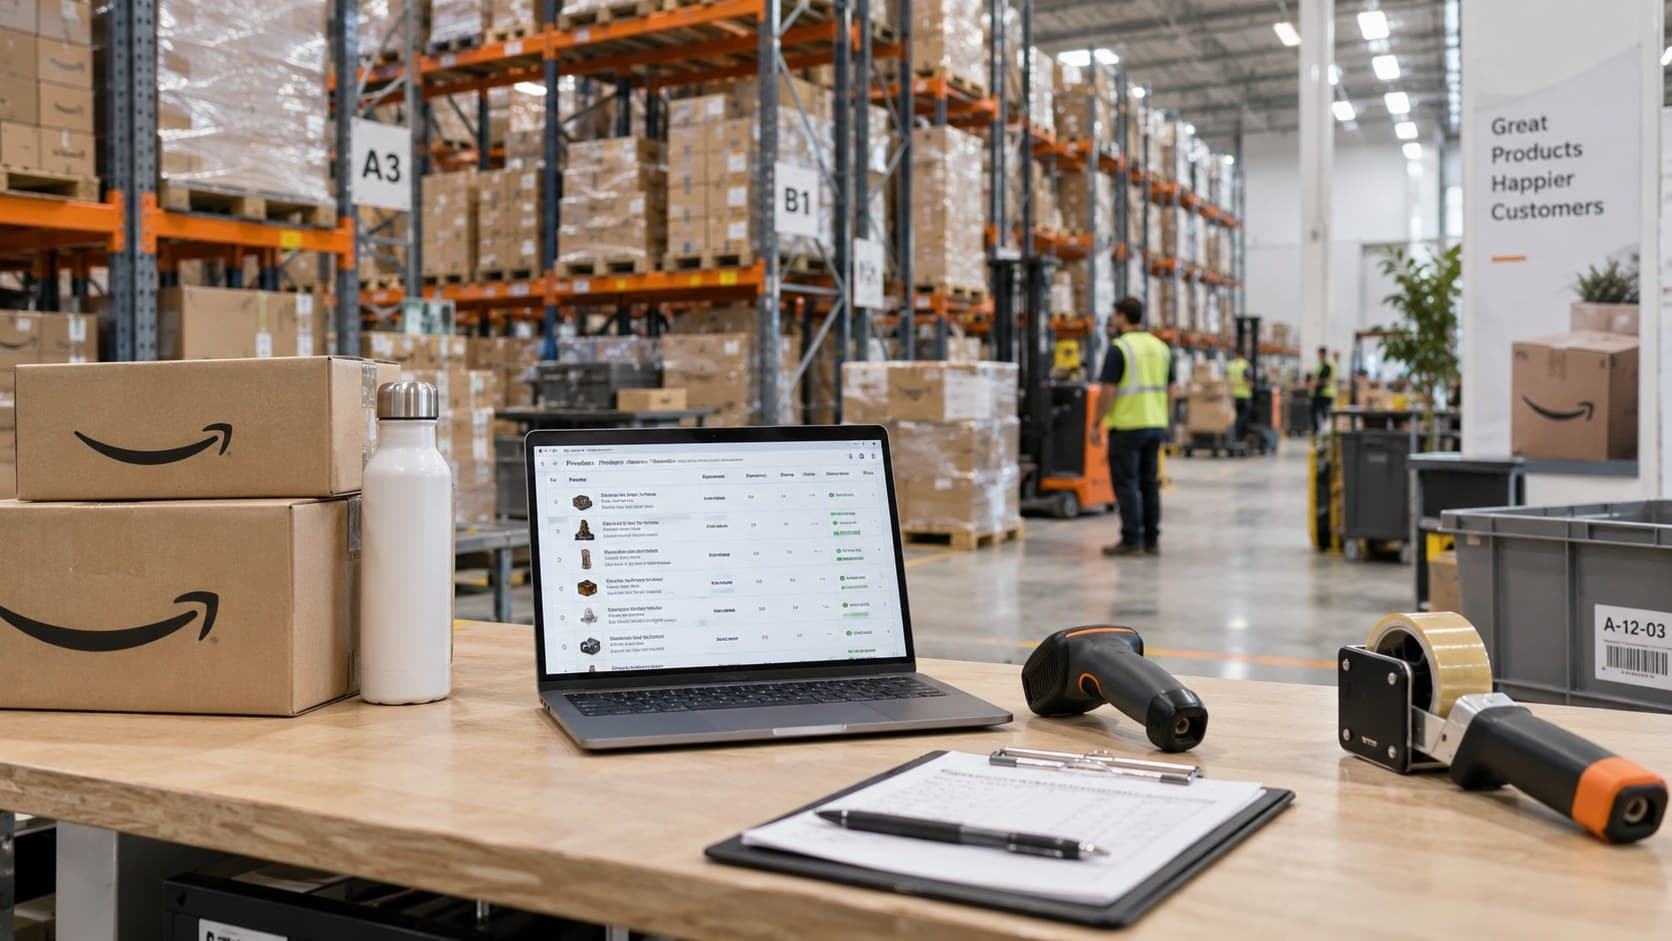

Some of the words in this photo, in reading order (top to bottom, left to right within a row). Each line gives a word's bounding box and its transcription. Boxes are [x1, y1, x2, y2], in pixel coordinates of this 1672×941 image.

[1491, 116, 1548, 135] Great
[1491, 142, 1583, 163] Products
[363, 150, 400, 182] A3
[1491, 171, 1574, 194] Happier
[785, 187, 809, 215] B1
[1491, 200, 1604, 221] Customers
[1604, 616, 1666, 639] A-12-03
